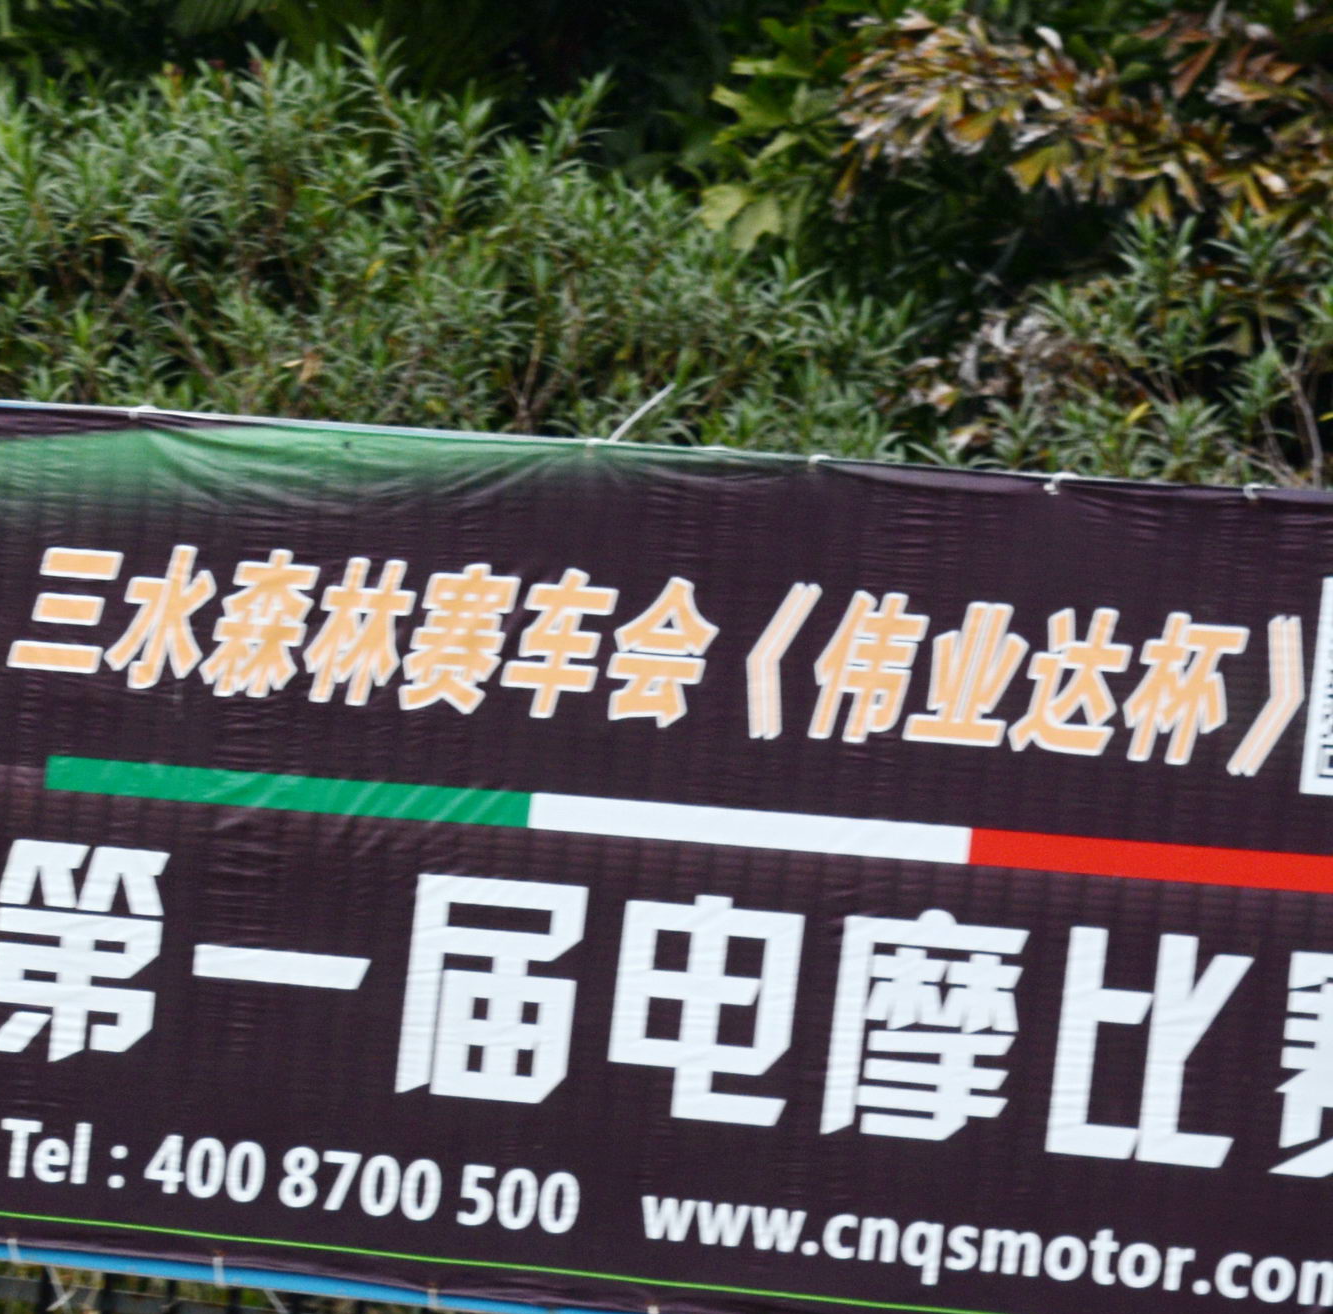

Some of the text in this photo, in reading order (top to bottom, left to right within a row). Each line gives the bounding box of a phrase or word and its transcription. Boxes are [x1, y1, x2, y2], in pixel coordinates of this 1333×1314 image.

[144, 1134, 266, 1203] 400
[278, 1146, 442, 1221] 8700
[456, 1164, 580, 1234] 500
